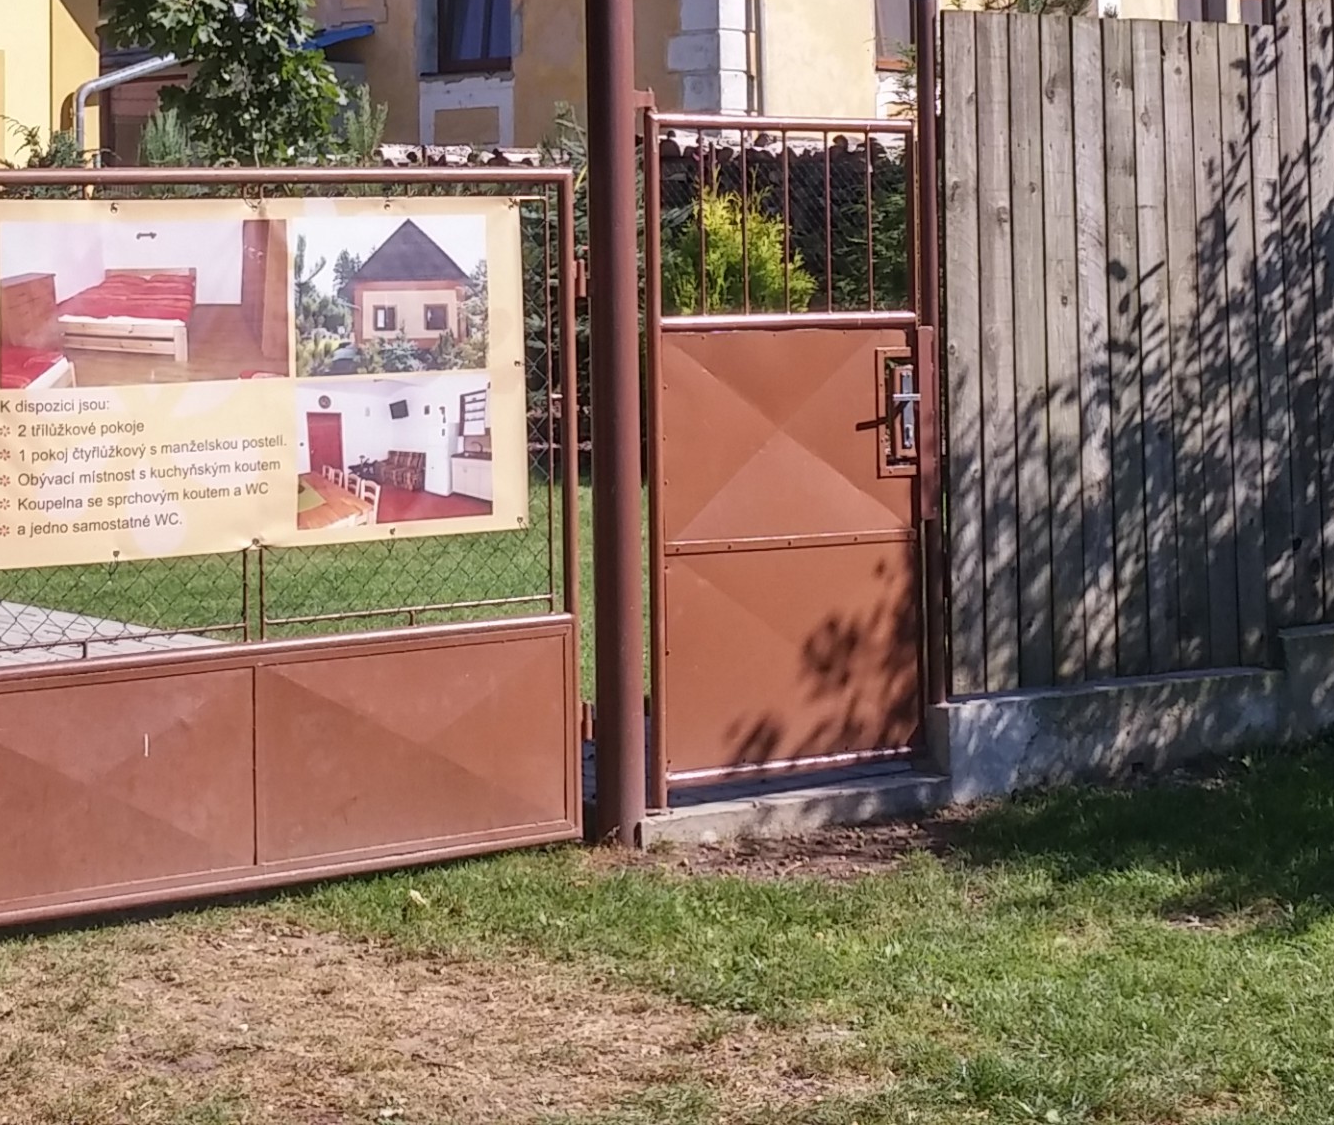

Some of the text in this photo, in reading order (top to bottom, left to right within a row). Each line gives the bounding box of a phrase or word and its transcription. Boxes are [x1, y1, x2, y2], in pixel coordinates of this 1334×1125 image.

[0, 399, 110, 415] K dispozici jsou:
[17, 424, 27, 438] 2
[100, 419, 145, 438] pokoje
[19, 449, 26, 462] 1
[31, 447, 68, 464] pokoj
[72, 443, 146, 463] čtyřlůžkový
[149, 445, 158, 456] s
[160, 438, 239, 455] manželskou
[17, 459, 282, 489] Obývací místnost s kuchyňským koutem
[17, 481, 270, 513] Koupelna se sprchovým koutem a WC
[17, 511, 183, 539] a jedno samostatné WC.
